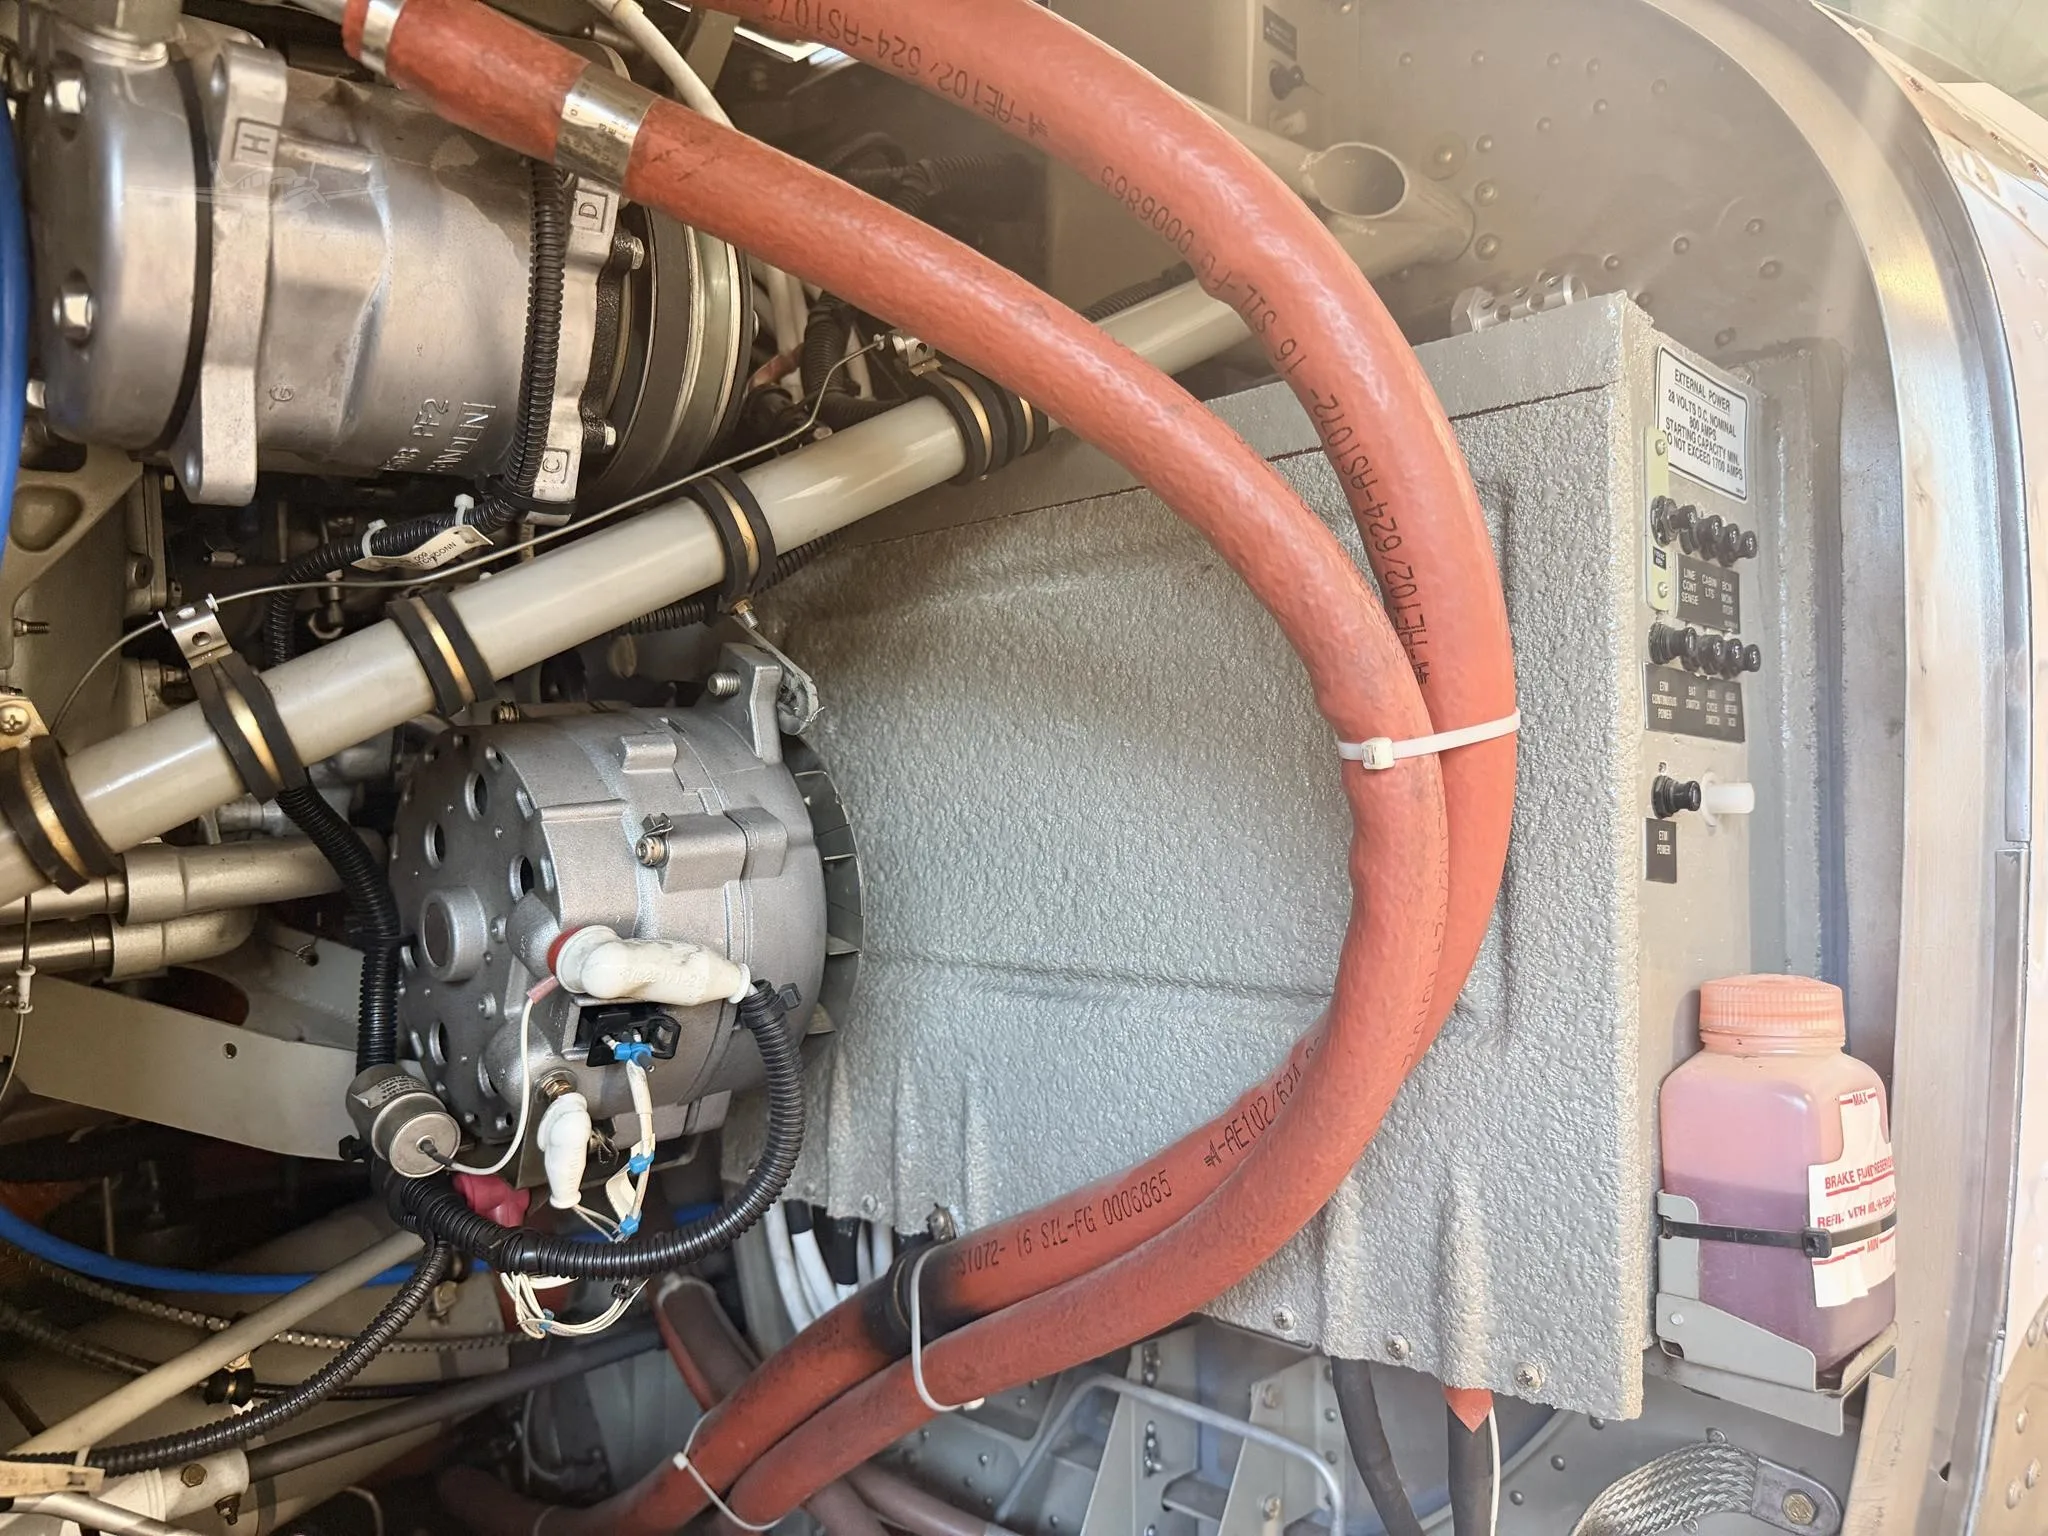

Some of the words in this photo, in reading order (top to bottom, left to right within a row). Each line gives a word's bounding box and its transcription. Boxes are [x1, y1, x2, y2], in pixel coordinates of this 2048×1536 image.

[578, 200, 600, 220] D
[1101, 166, 1195, 254] 0006865
[1674, 369, 1706, 399] EXTERNAL
[1708, 390, 1731, 411] POWER
[1668, 389, 1676, 405] 28
[1676, 392, 1697, 416] VOLTS
[1697, 404, 1709, 424] D.C.
[1709, 412, 1737, 438] NOMINAL
[1665, 416, 1697, 446] STARTING
[1696, 432, 1727, 458] CAPACITY
[1727, 450, 1740, 466] MIN.
[1701, 422, 1717, 441] AMPS
[1673, 435, 1686, 454] NOT
[1687, 441, 1711, 466] EXCEED
[1711, 456, 1725, 473] 1700
[1726, 461, 1744, 481] AMPS
[1658, 708, 1673, 720] POWER
[1656, 844, 1671, 855] POWER
[1852, 1092, 1868, 1106] MAX
[1824, 1170, 1856, 1190] BRAKE
[1041, 1205, 1097, 1249] SIL-FG
[1102, 1169, 1172, 1226] 0006865
